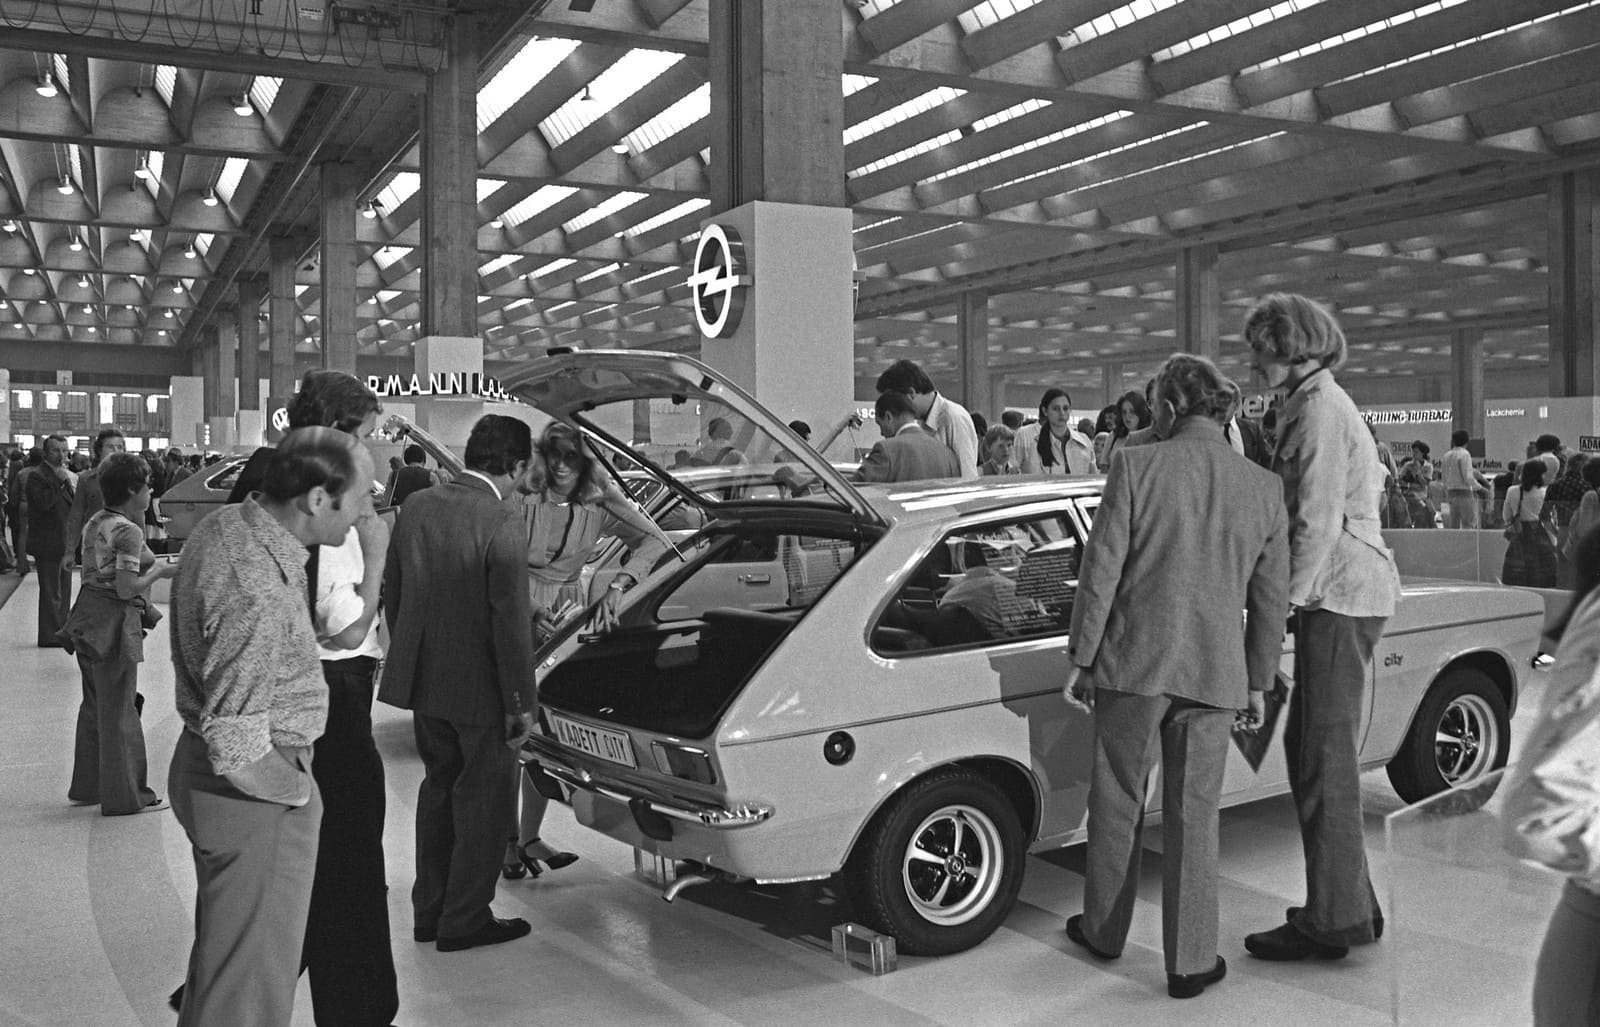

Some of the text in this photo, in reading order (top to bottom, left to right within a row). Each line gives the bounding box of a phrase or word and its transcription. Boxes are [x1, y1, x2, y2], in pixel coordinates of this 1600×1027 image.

[366, 373, 462, 396] RMANN
[1384, 652, 1404, 667] city
[557, 720, 628, 761] KADETT CITY
